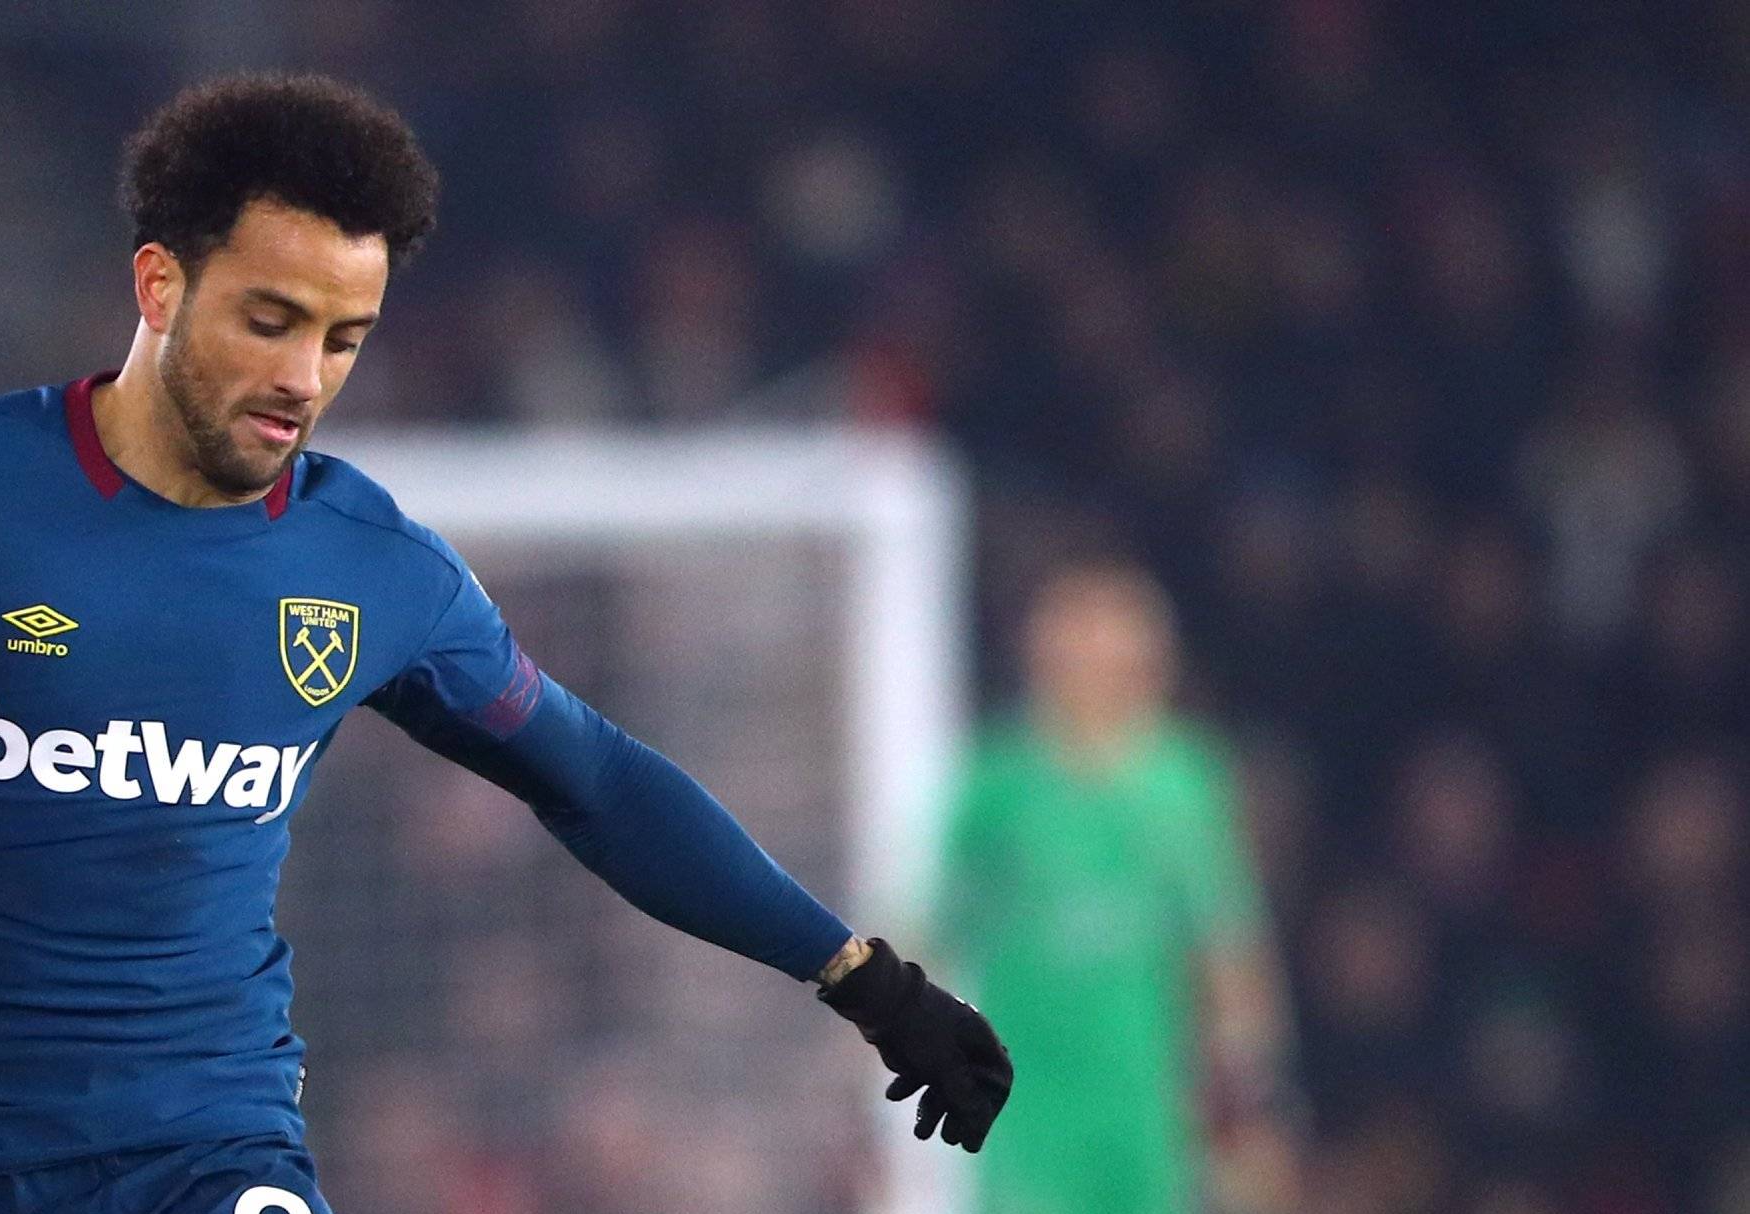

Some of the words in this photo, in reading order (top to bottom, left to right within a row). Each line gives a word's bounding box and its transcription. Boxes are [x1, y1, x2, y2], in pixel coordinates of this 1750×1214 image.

[289, 604, 320, 617] WEST
[322, 607, 350, 622] HAM
[301, 616, 337, 628] UNITED
[7, 638, 69, 657] umbro
